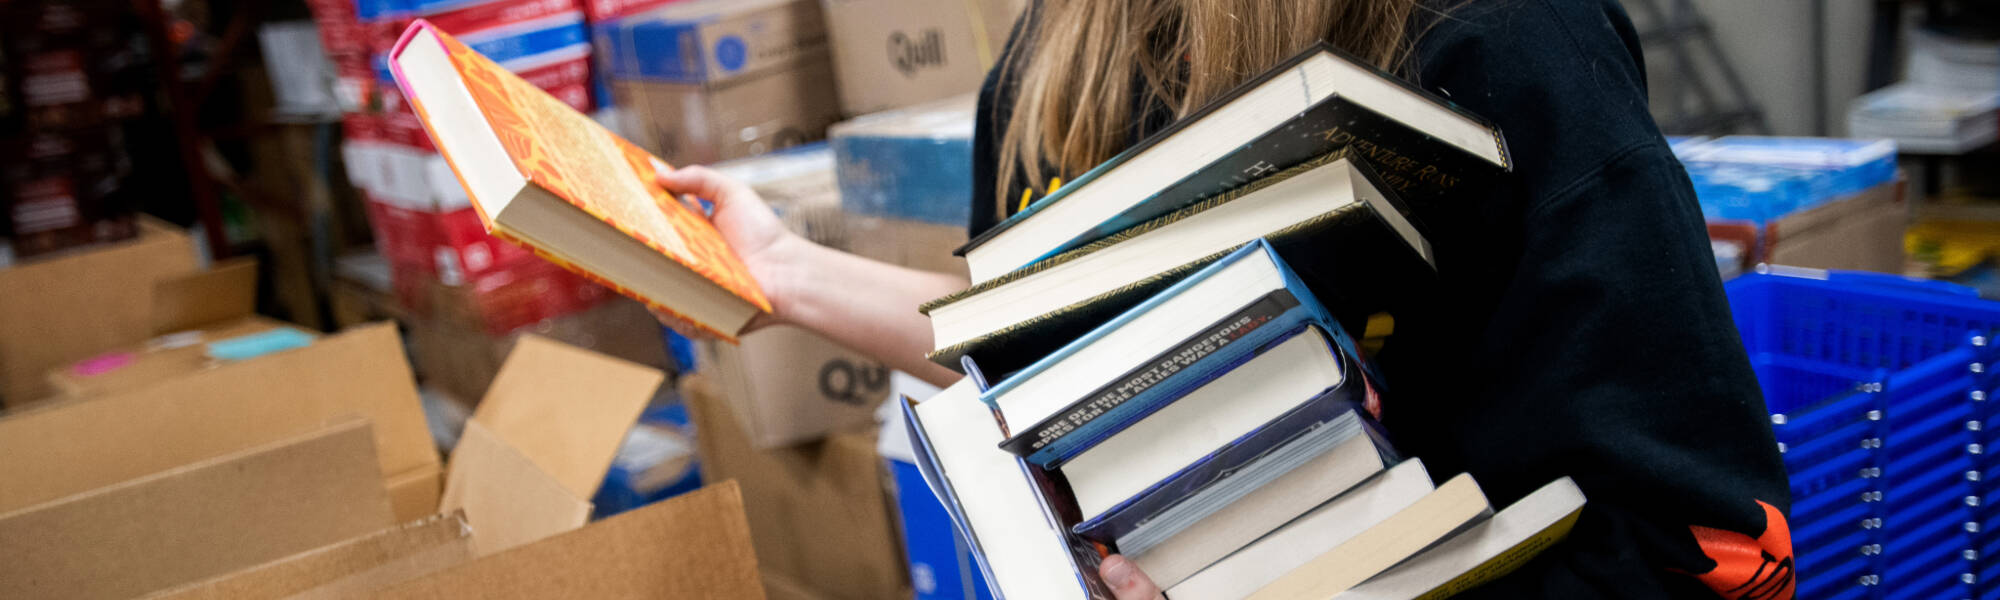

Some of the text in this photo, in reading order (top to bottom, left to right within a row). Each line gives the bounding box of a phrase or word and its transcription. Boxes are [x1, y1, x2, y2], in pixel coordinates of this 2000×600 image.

[886, 28, 947, 78] Quill
[1031, 424, 1074, 449] SPIES
[1074, 407, 1104, 426] FOR
[1102, 391, 1133, 409] THE
[1133, 364, 1181, 394] ALLIES
[1180, 345, 1217, 366] WAS
[1218, 338, 1230, 346] A
[1038, 315, 1252, 438] ONE OF THE MOST DANGEROUS
